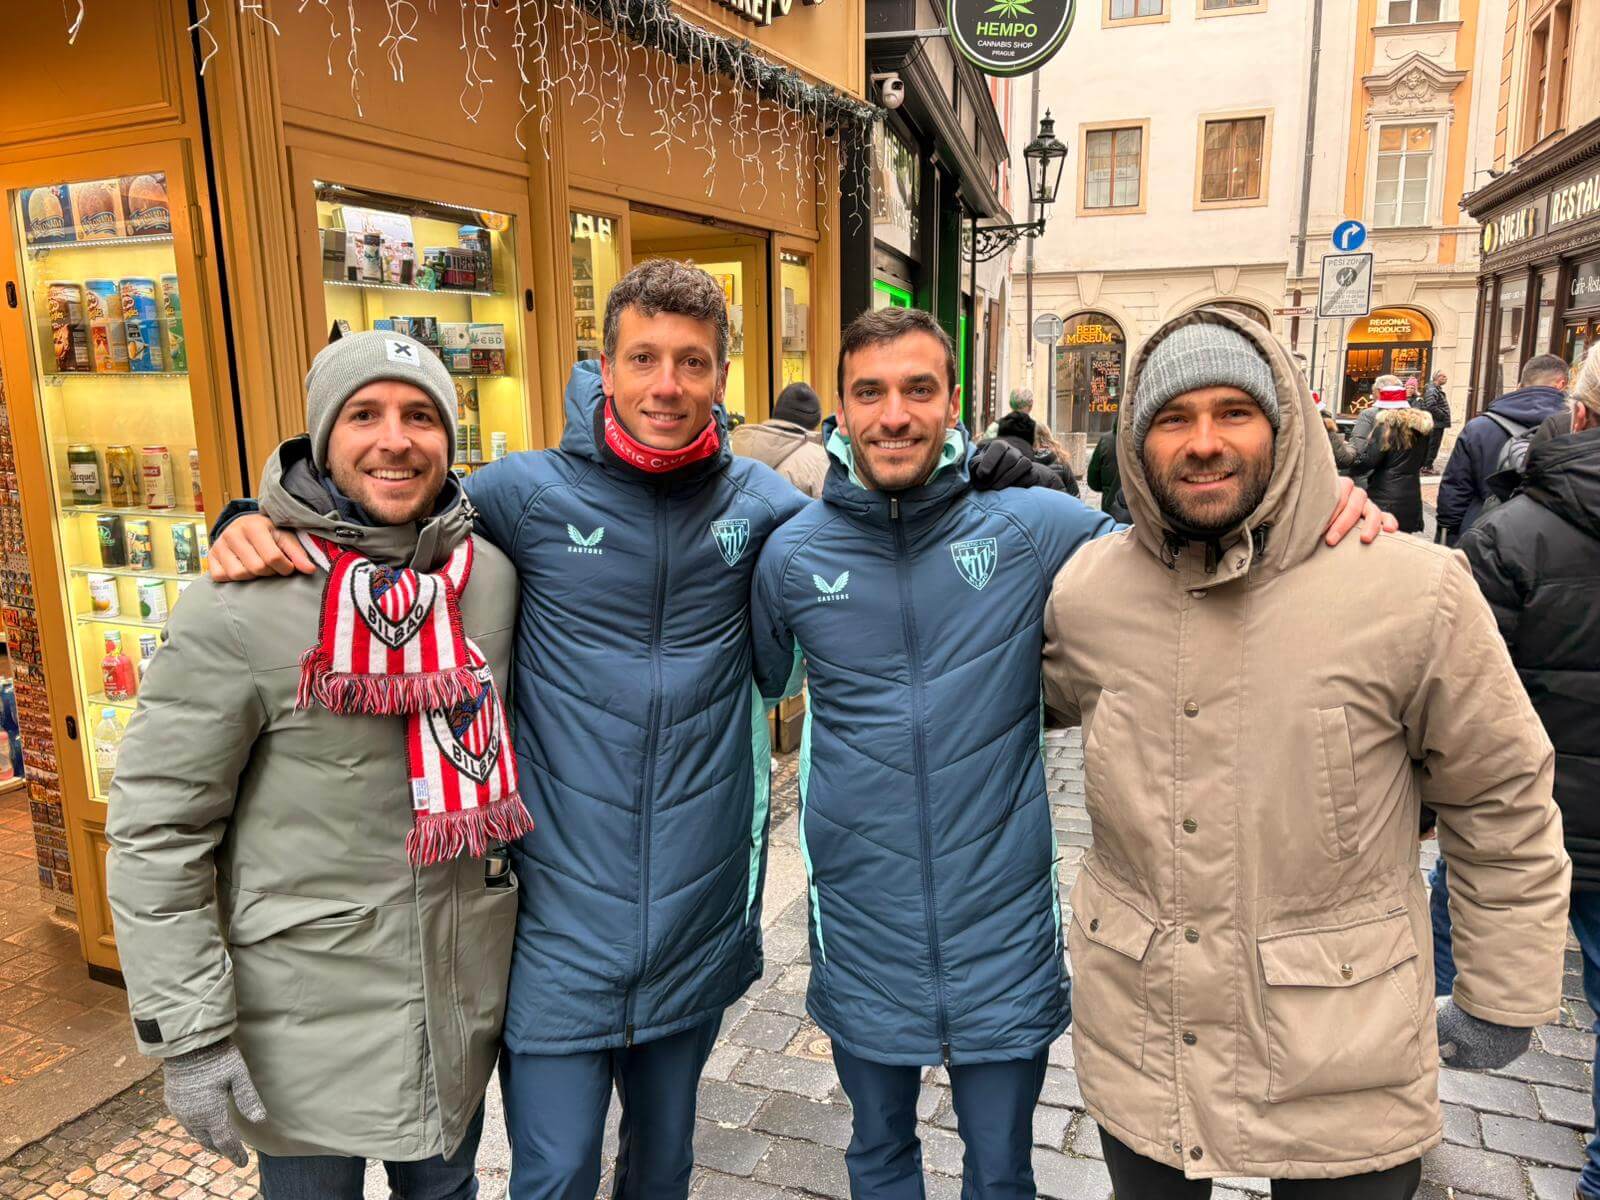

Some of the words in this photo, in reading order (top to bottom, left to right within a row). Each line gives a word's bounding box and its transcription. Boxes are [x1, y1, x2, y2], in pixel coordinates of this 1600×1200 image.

[976, 21, 1038, 38] HEMPO
[977, 40, 1012, 49] CANNABIS
[1013, 41, 1033, 49] SHOP
[1369, 318, 1411, 326] REGIONAL
[1076, 324, 1103, 334] BEER
[1367, 325, 1412, 334] PRODUCTS
[1066, 333, 1112, 344] MUSEUM
[368, 604, 424, 644] BILBAO
[453, 736, 498, 777] BILBAO
